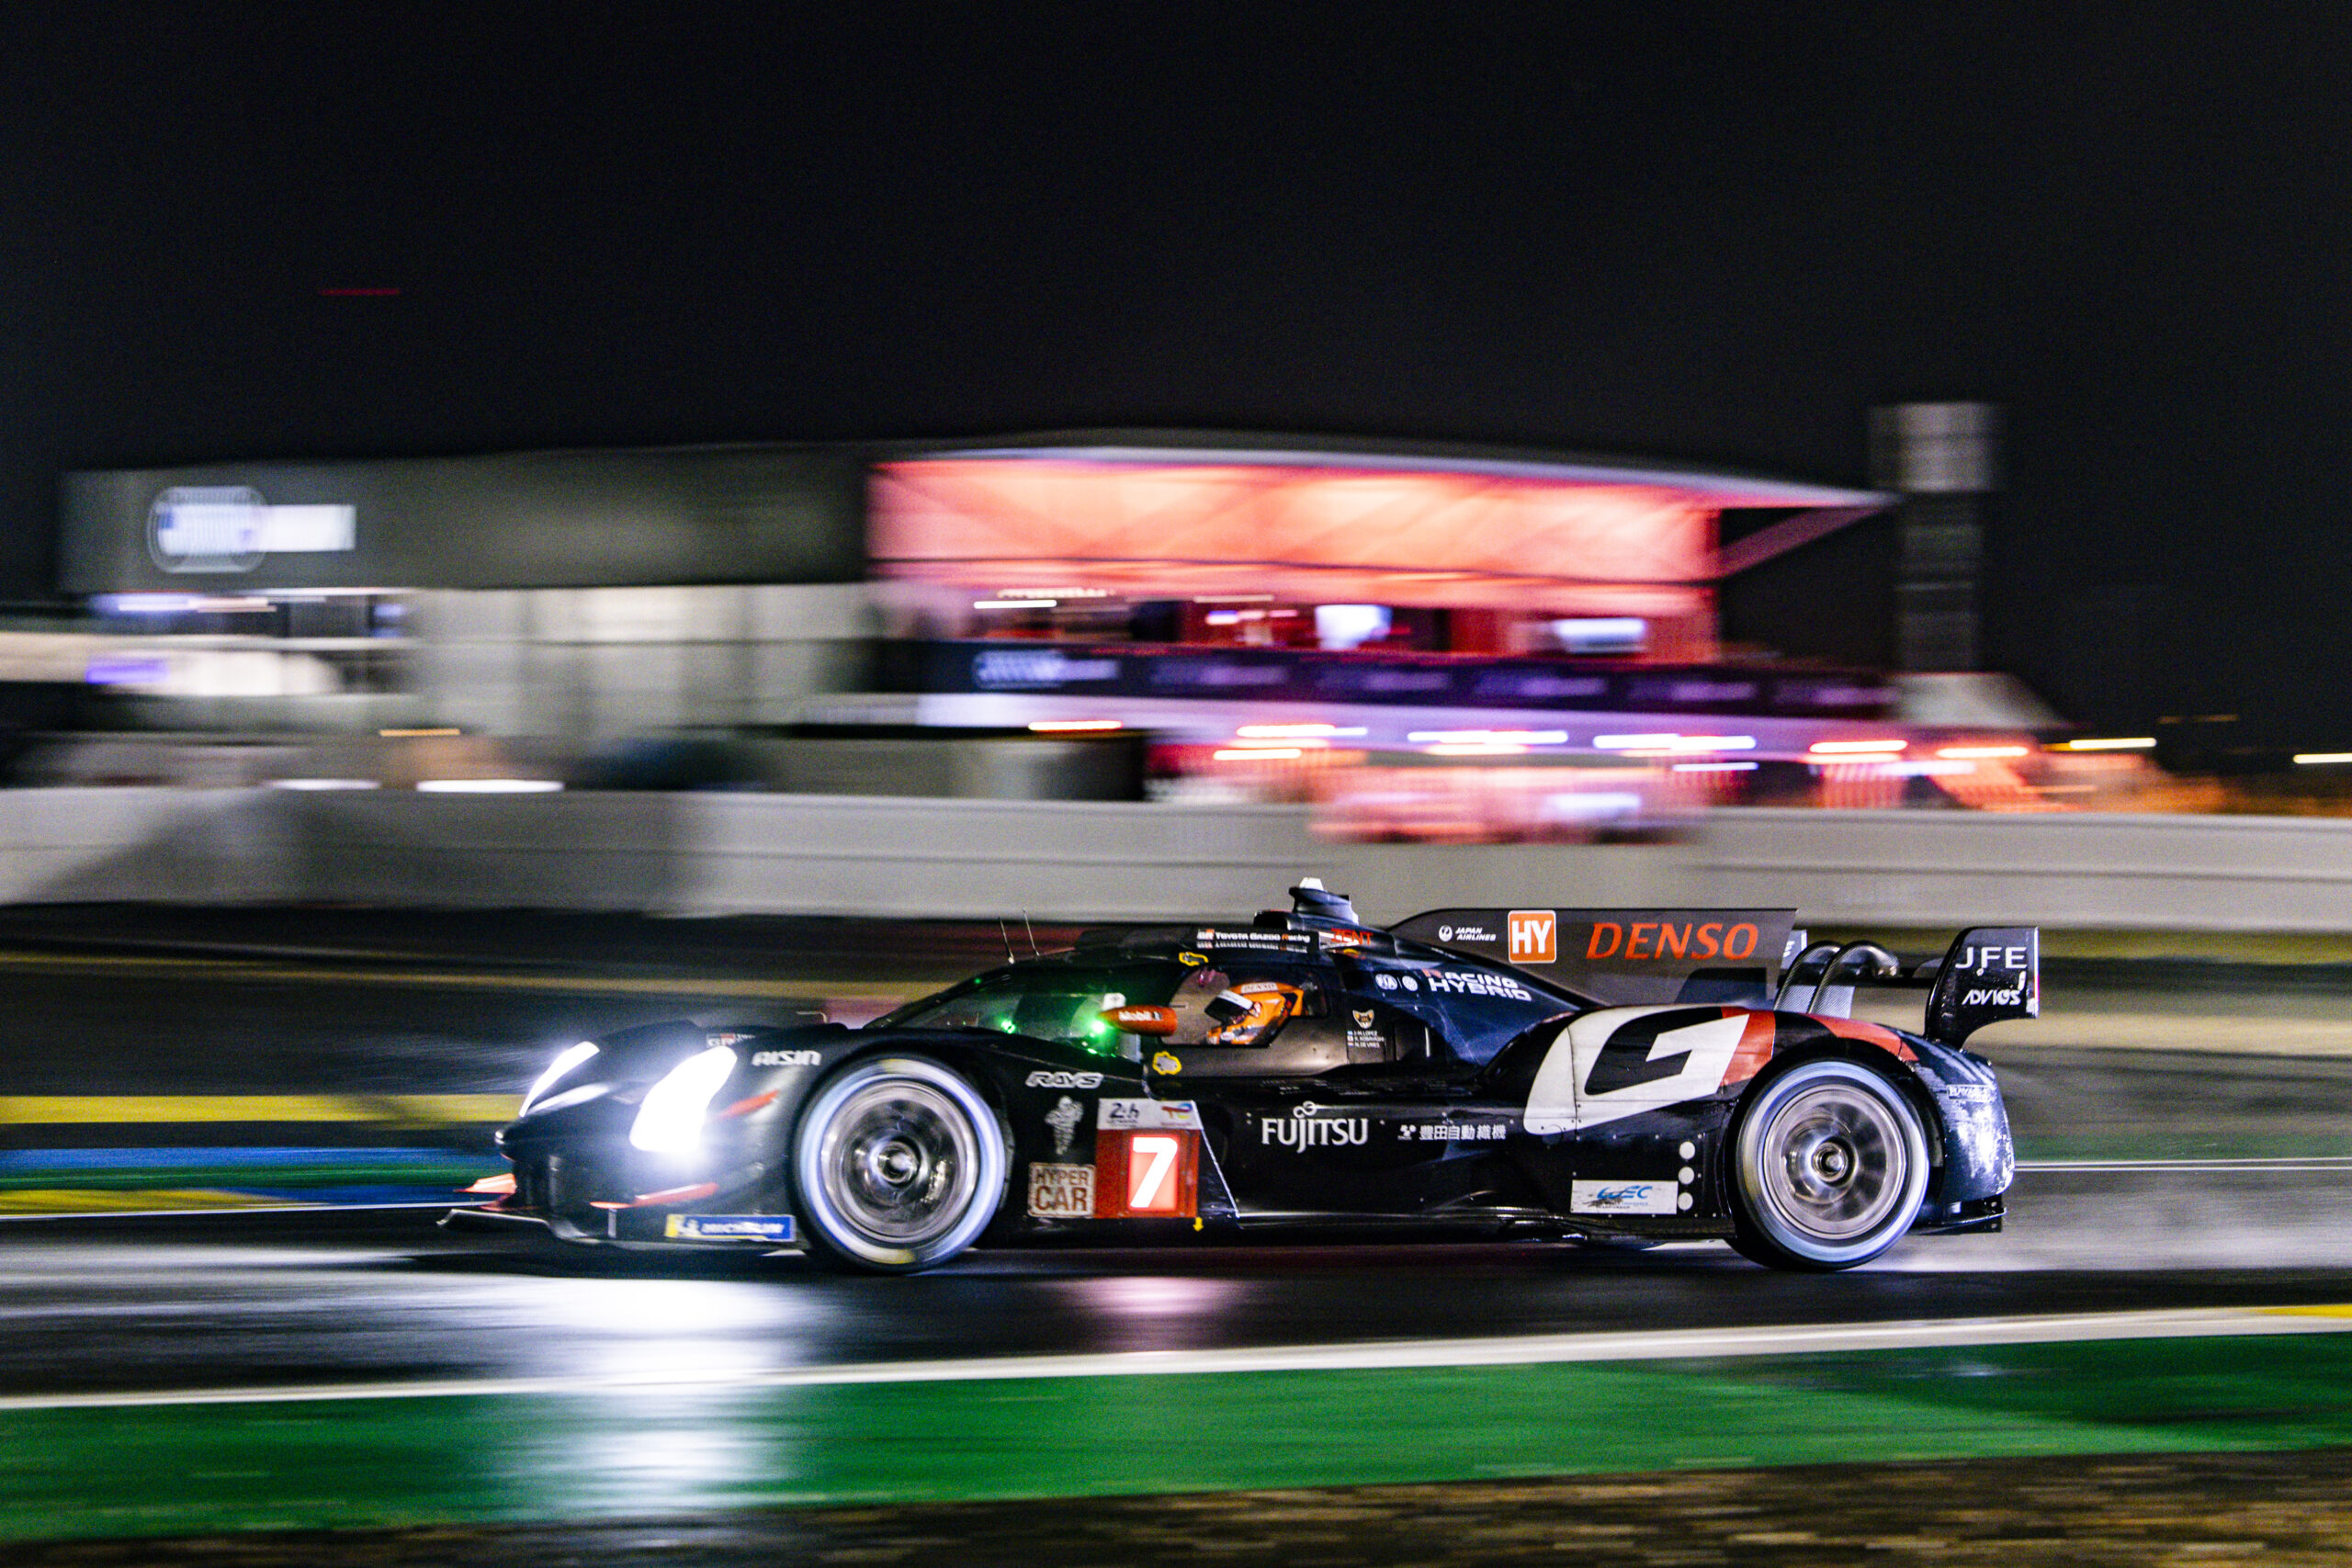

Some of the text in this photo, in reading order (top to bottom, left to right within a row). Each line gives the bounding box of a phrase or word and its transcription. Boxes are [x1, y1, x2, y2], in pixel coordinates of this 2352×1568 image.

[1216, 931, 1249, 940] TOYOTA
[1330, 928, 1374, 945] ZENT
[1511, 920, 1552, 954] HY
[1586, 922, 1759, 960] DENSO
[1955, 947, 2028, 968] JFE
[1423, 969, 1519, 989] RACING
[1429, 978, 1532, 1002] HYBRID
[752, 1050, 822, 1066] AISIN
[1025, 1071, 1103, 1089] RAYS
[1261, 1117, 1369, 1154] FUJITSU
[1035, 1168, 1089, 1186] HYPER
[1130, 1137, 1178, 1208] 7
[1035, 1185, 1088, 1211] CAR
